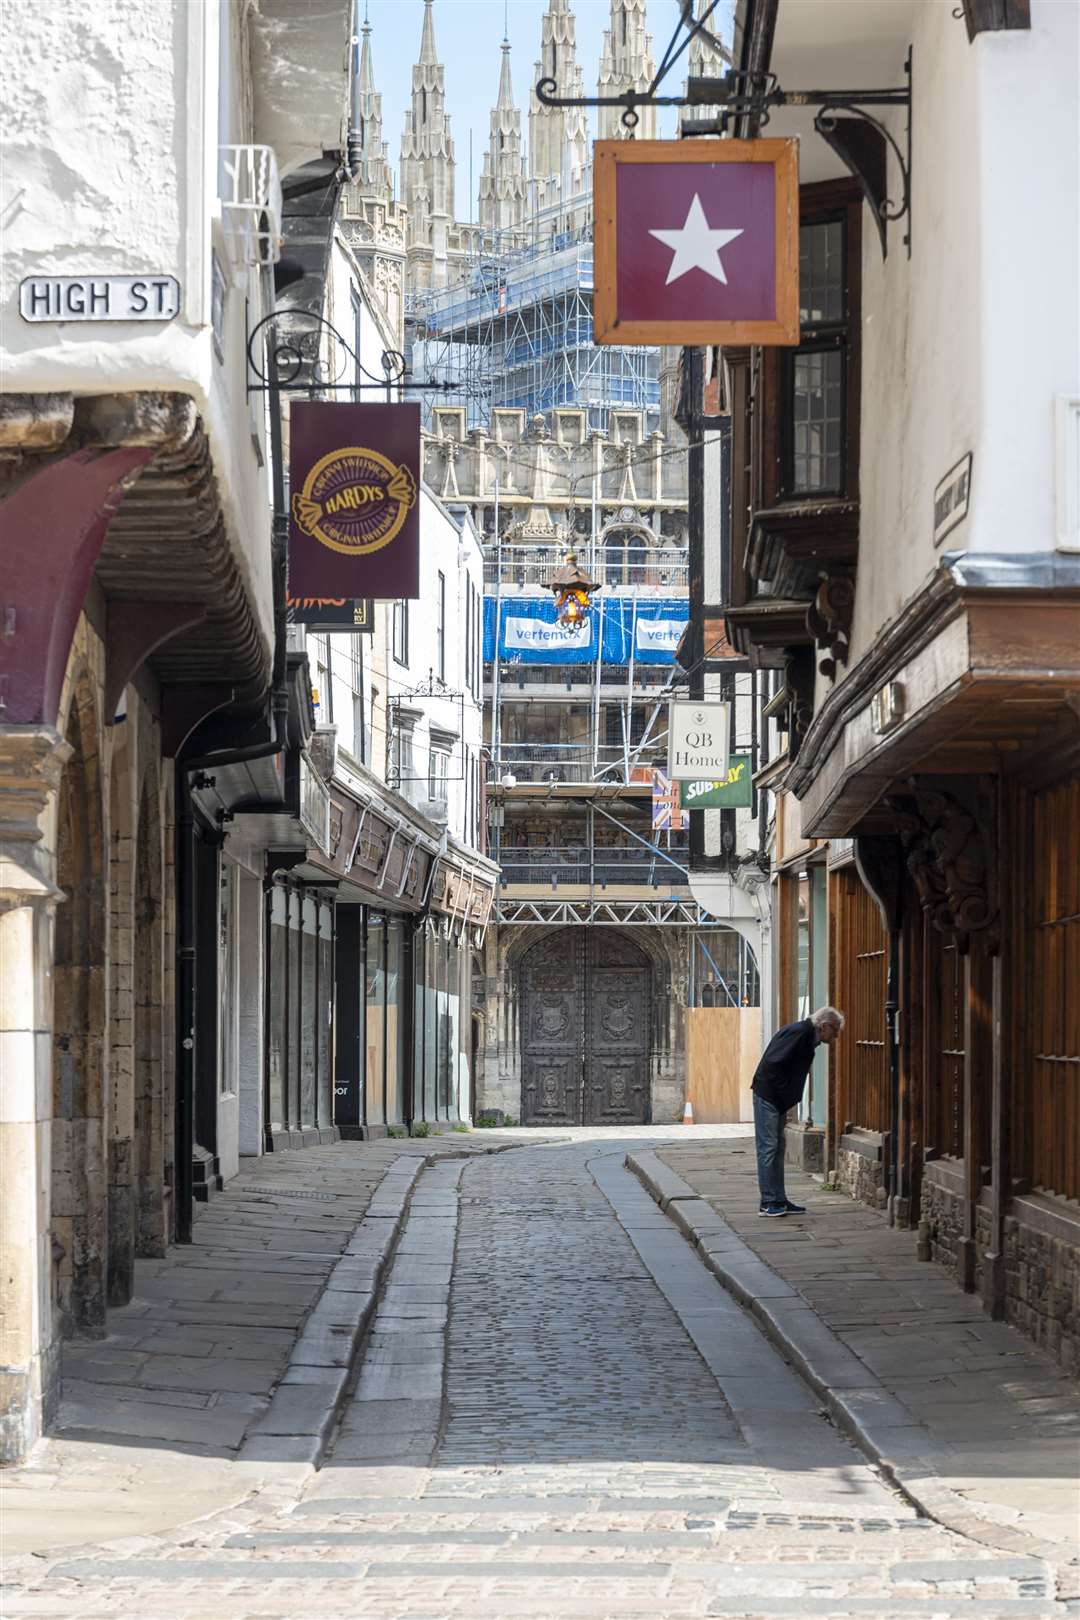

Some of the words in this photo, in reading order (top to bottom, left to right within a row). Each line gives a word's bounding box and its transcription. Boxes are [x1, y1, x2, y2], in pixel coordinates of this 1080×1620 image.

[31, 282, 110, 315] HIGH
[130, 282, 174, 313] ST.
[325, 485, 384, 514] HARDYS
[685, 731, 713, 749] QB
[675, 751, 723, 766] Home
